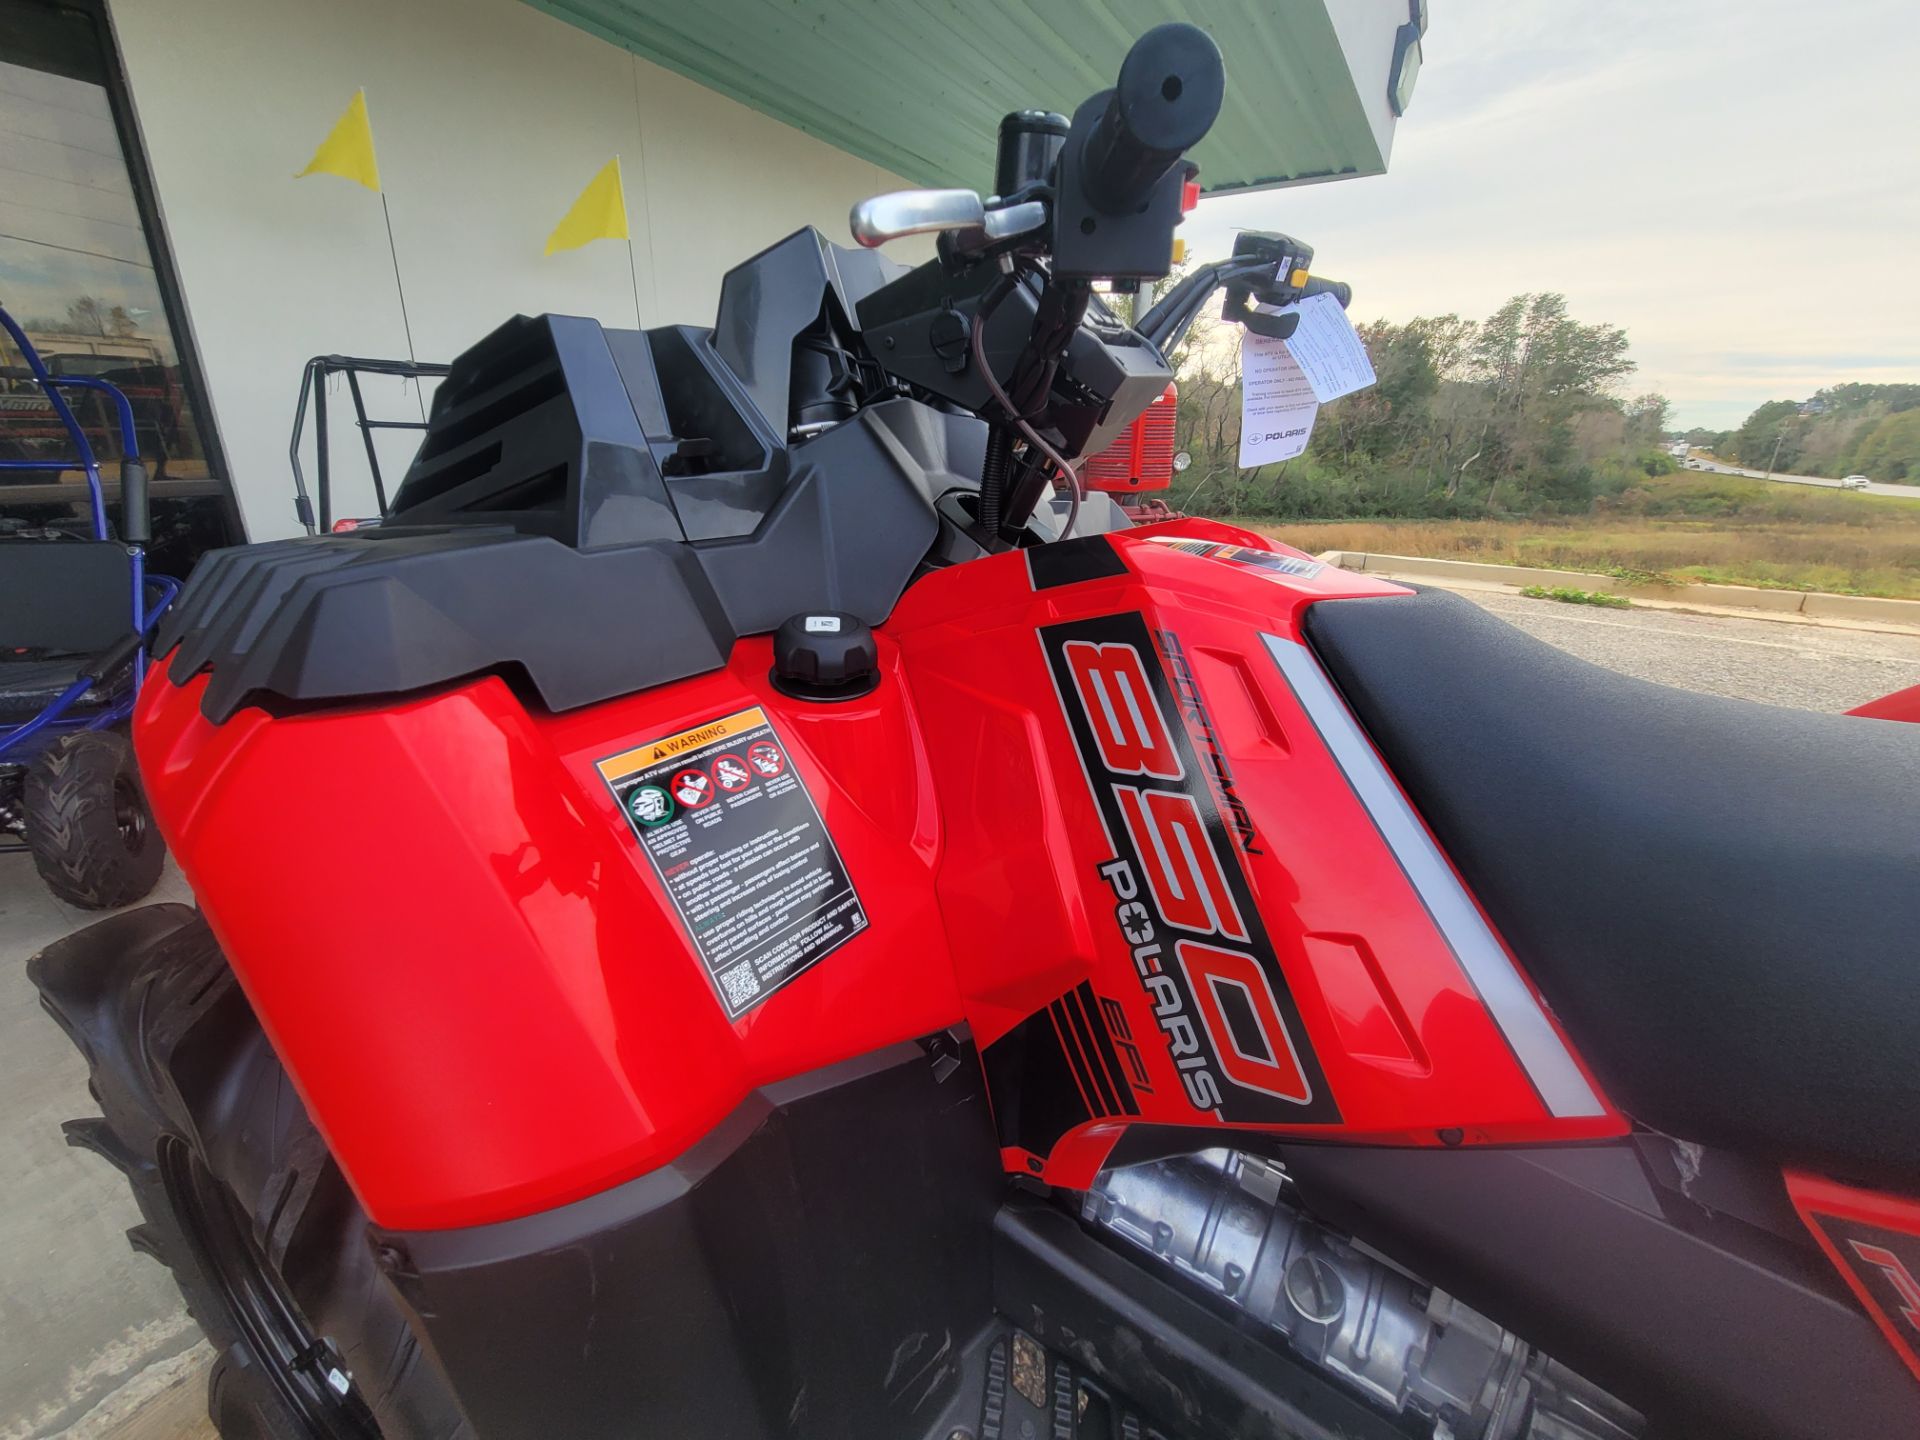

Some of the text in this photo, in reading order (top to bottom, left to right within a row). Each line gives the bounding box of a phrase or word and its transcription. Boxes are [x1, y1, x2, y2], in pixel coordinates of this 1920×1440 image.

[1264, 427, 1307, 442] POLARIS
[614, 776, 644, 790] Improper
[644, 770, 657, 779] ATV
[703, 744, 727, 756] SEVERE
[726, 737, 746, 748] INJURY
[752, 728, 771, 738] DEATH
[667, 725, 726, 751] WARNING
[1154, 628, 1264, 855] SPORTSMAN
[691, 808, 709, 818] NEVER
[704, 809, 723, 820] PUBLIC
[726, 786, 759, 803] NEVER CARRY
[730, 792, 762, 808] PASSENGERS
[647, 819, 683, 838] ALWAYS USE
[652, 831, 689, 850] HELMET AND
[656, 838, 691, 856] PROTECTIVE
[657, 825, 687, 841] APPROVED
[703, 817, 722, 828] ROADS
[666, 862, 687, 876] NEVER
[670, 847, 686, 857] GEAR
[673, 867, 698, 882] without
[698, 857, 719, 872] proper
[719, 846, 743, 860] training
[749, 829, 779, 845] instruction
[686, 872, 709, 886] speeds
[708, 867, 720, 875] too
[719, 860, 732, 869] fast
[740, 850, 753, 860] your
[753, 843, 767, 853] skills
[783, 822, 809, 838] conditions
[690, 904, 704, 913] with
[710, 885, 740, 905] passenger
[744, 866, 775, 887] passengers
[775, 857, 791, 869] affect
[790, 848, 810, 861] balance
[810, 842, 819, 851] and
[692, 880, 712, 895] public
[712, 871, 730, 883] roads
[738, 855, 763, 869] collision
[763, 849, 773, 857] can
[773, 841, 788, 851] occur
[788, 835, 800, 844] with
[1062, 640, 1312, 1106] 850
[686, 879, 732, 906] another vehicle
[694, 857, 808, 922] steering and increase risk of losing control
[703, 928, 715, 938] use
[715, 916, 735, 932] proper
[736, 906, 754, 919] riding
[753, 890, 784, 909] techniques
[790, 877, 805, 888] avoid
[805, 868, 822, 880] vehicle
[706, 927, 736, 946] overturns
[736, 921, 745, 929] on
[744, 914, 758, 924] hills
[758, 906, 769, 916] and
[769, 897, 786, 910] rough
[785, 888, 803, 900] terrain
[803, 881, 813, 890] and
[711, 879, 833, 954] avoid paved surfaces pavement may seriously
[714, 914, 789, 962] affect handling and control
[754, 897, 856, 965] SCAN CODE FOR PRODUCT AND SAFETY
[758, 945, 798, 973] INFORMATION.
[800, 928, 823, 946] FOLLOW
[823, 922, 834, 931] ALL
[762, 951, 803, 981] INSTRUCTIONS
[804, 942, 815, 953] AND
[815, 924, 843, 945] WARNINGS.
[1101, 860, 1223, 1109] POLARIS
[1097, 995, 1155, 1096] EFI
